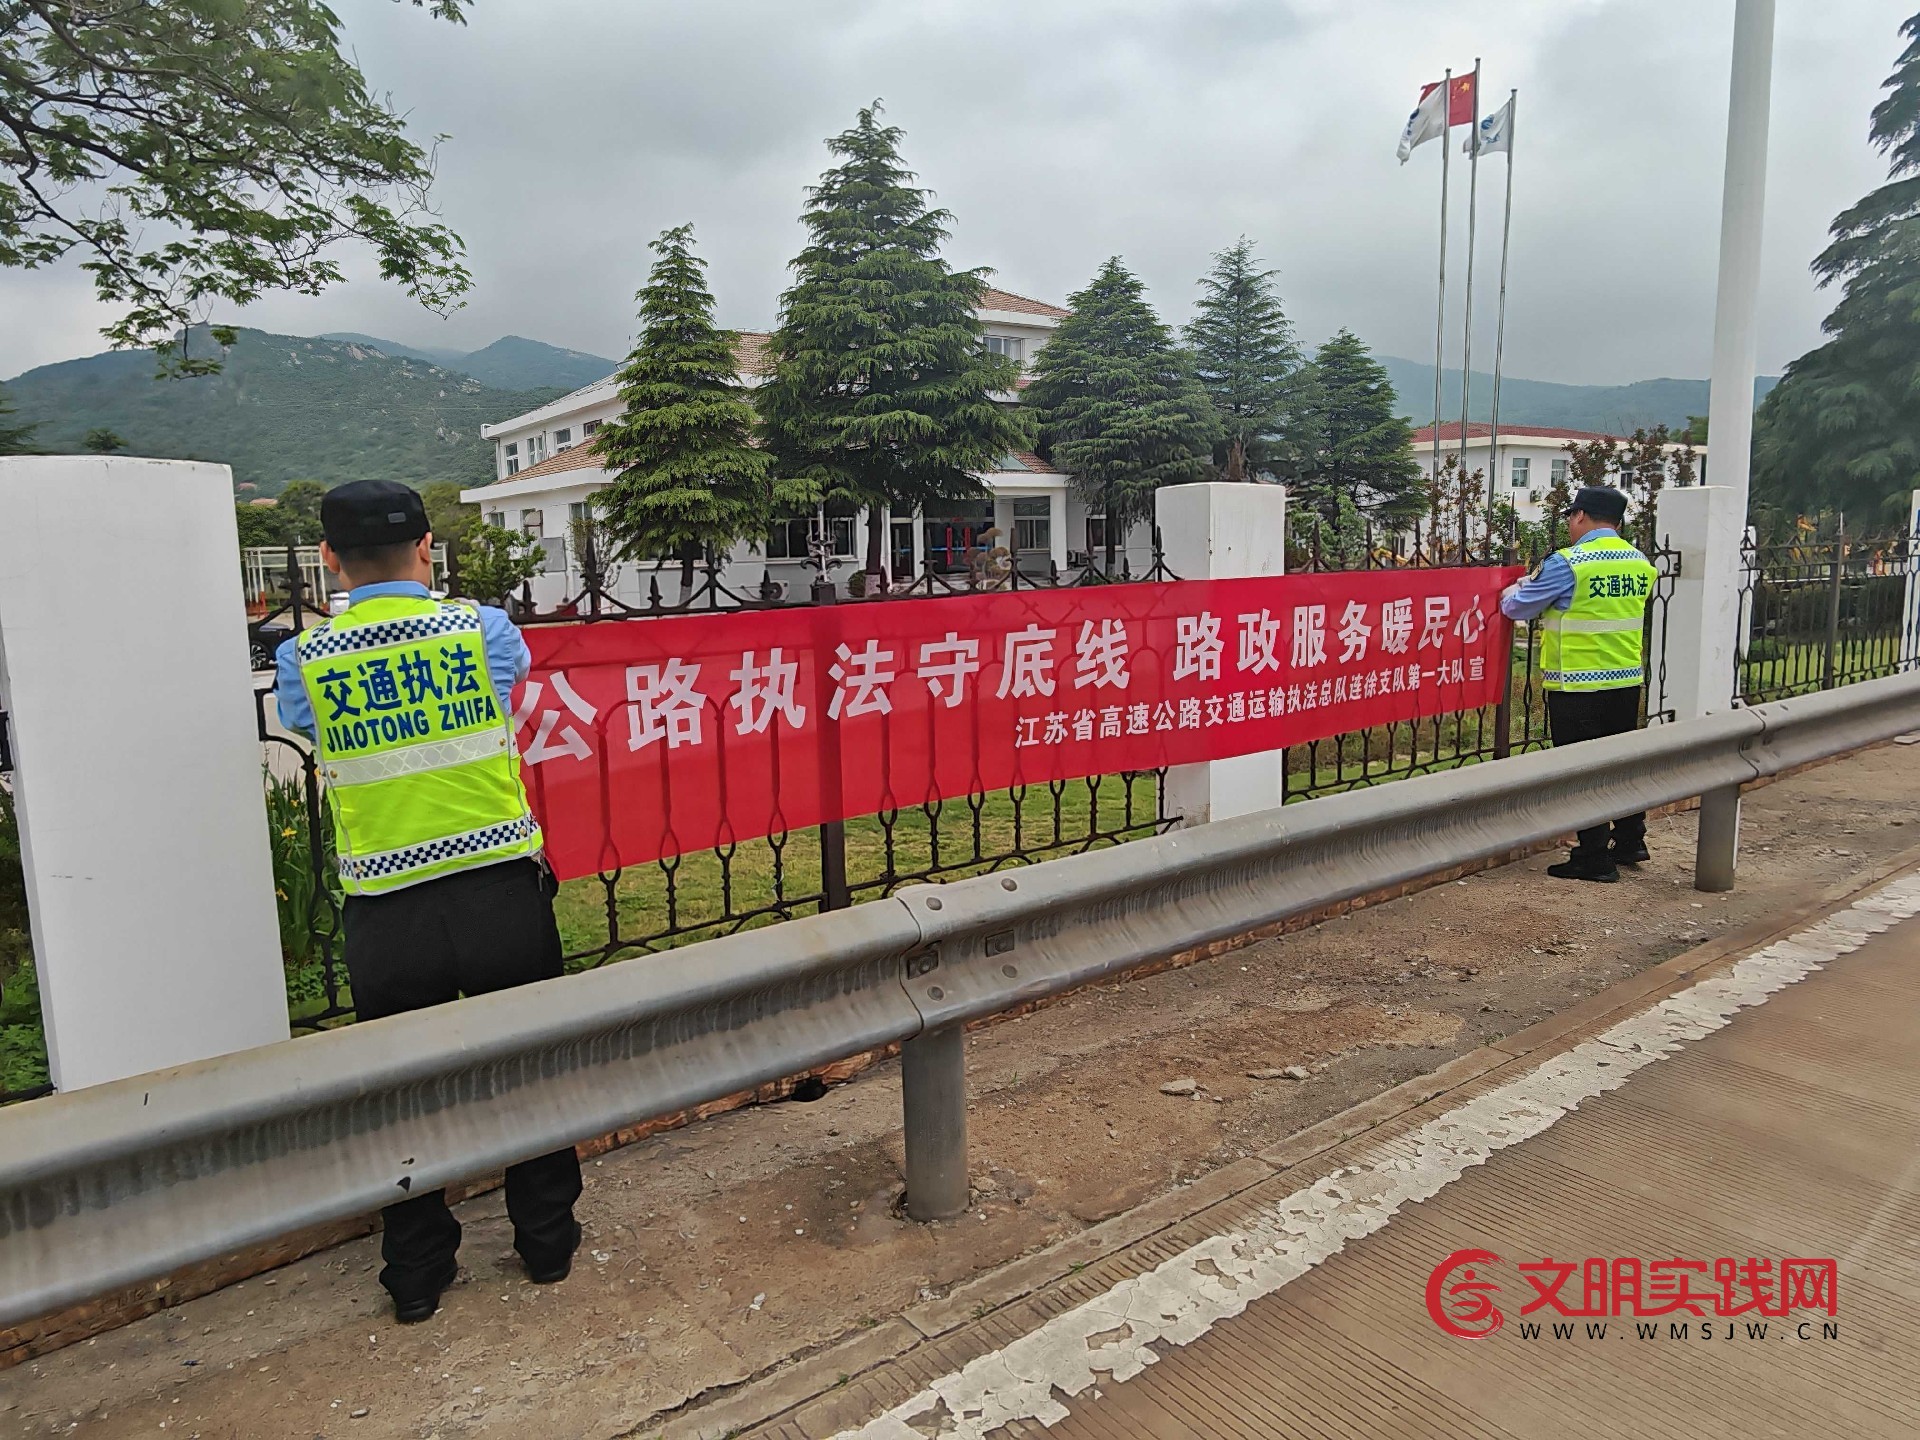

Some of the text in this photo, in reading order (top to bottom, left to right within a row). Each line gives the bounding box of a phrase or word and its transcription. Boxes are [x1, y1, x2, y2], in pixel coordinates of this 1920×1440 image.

[1589, 573, 1649, 599] 交通执法
[316, 643, 481, 722] 交通执法
[326, 695, 497, 754] JIAOTONG ZHIFA
